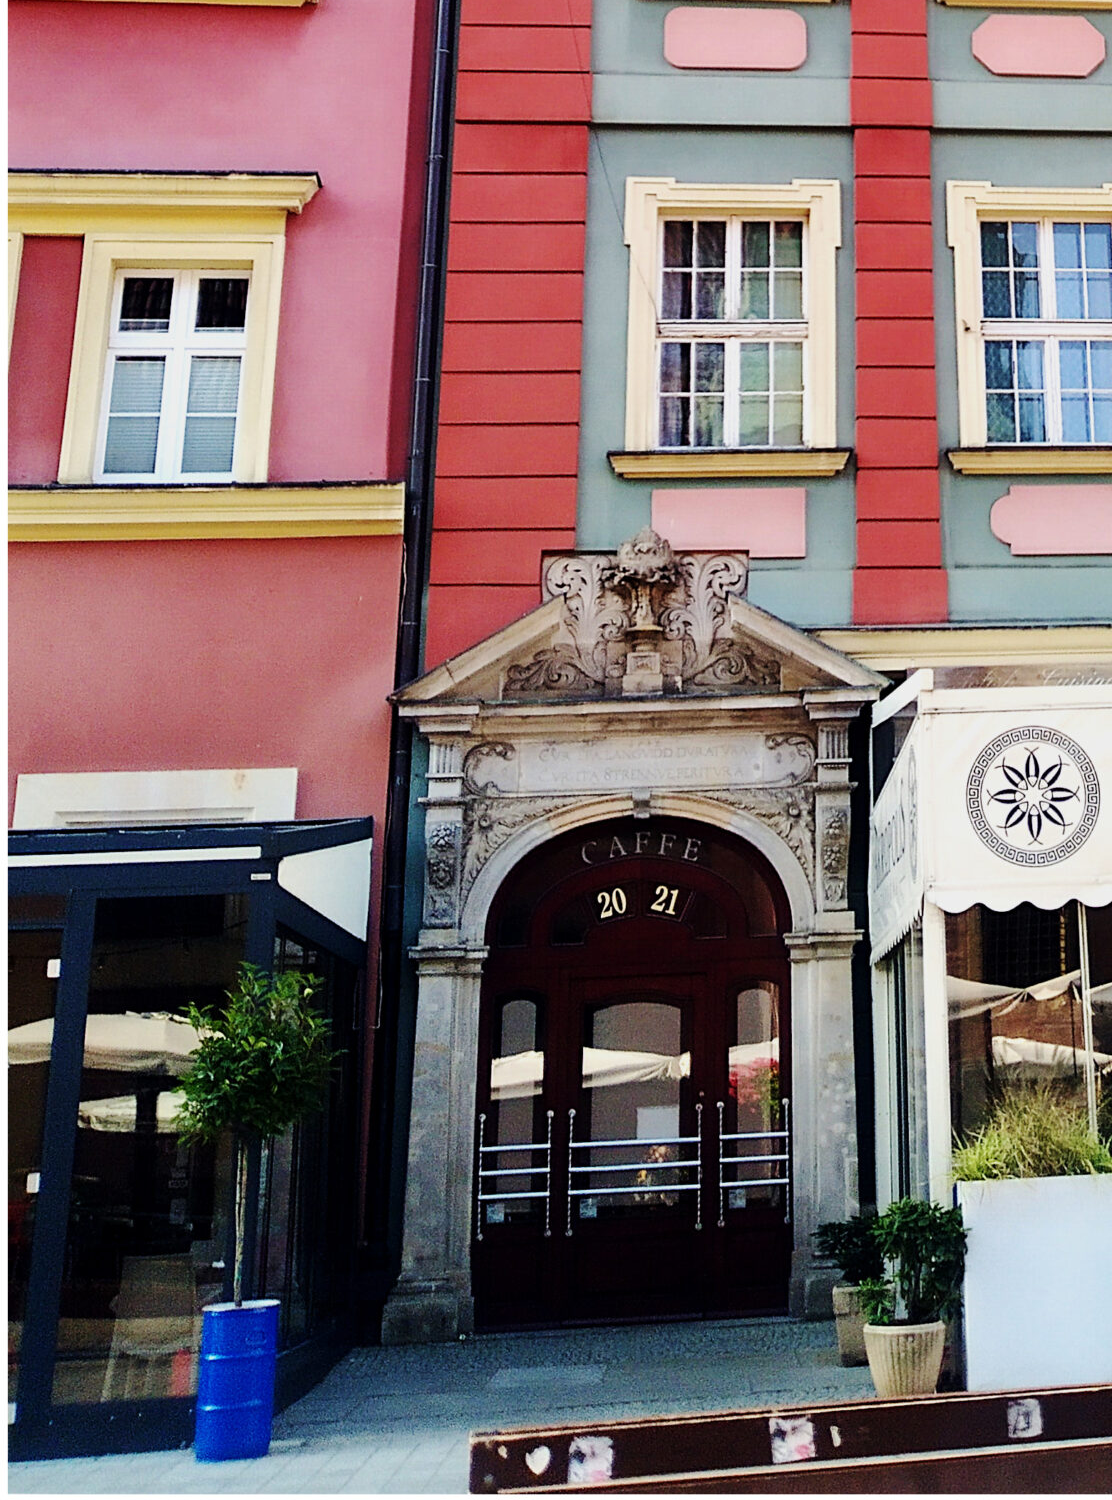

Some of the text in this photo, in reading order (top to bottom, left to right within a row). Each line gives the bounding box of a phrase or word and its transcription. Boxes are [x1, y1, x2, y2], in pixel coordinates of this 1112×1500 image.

[581, 831, 702, 864] CAFFE
[597, 885, 679, 919] 20 21
